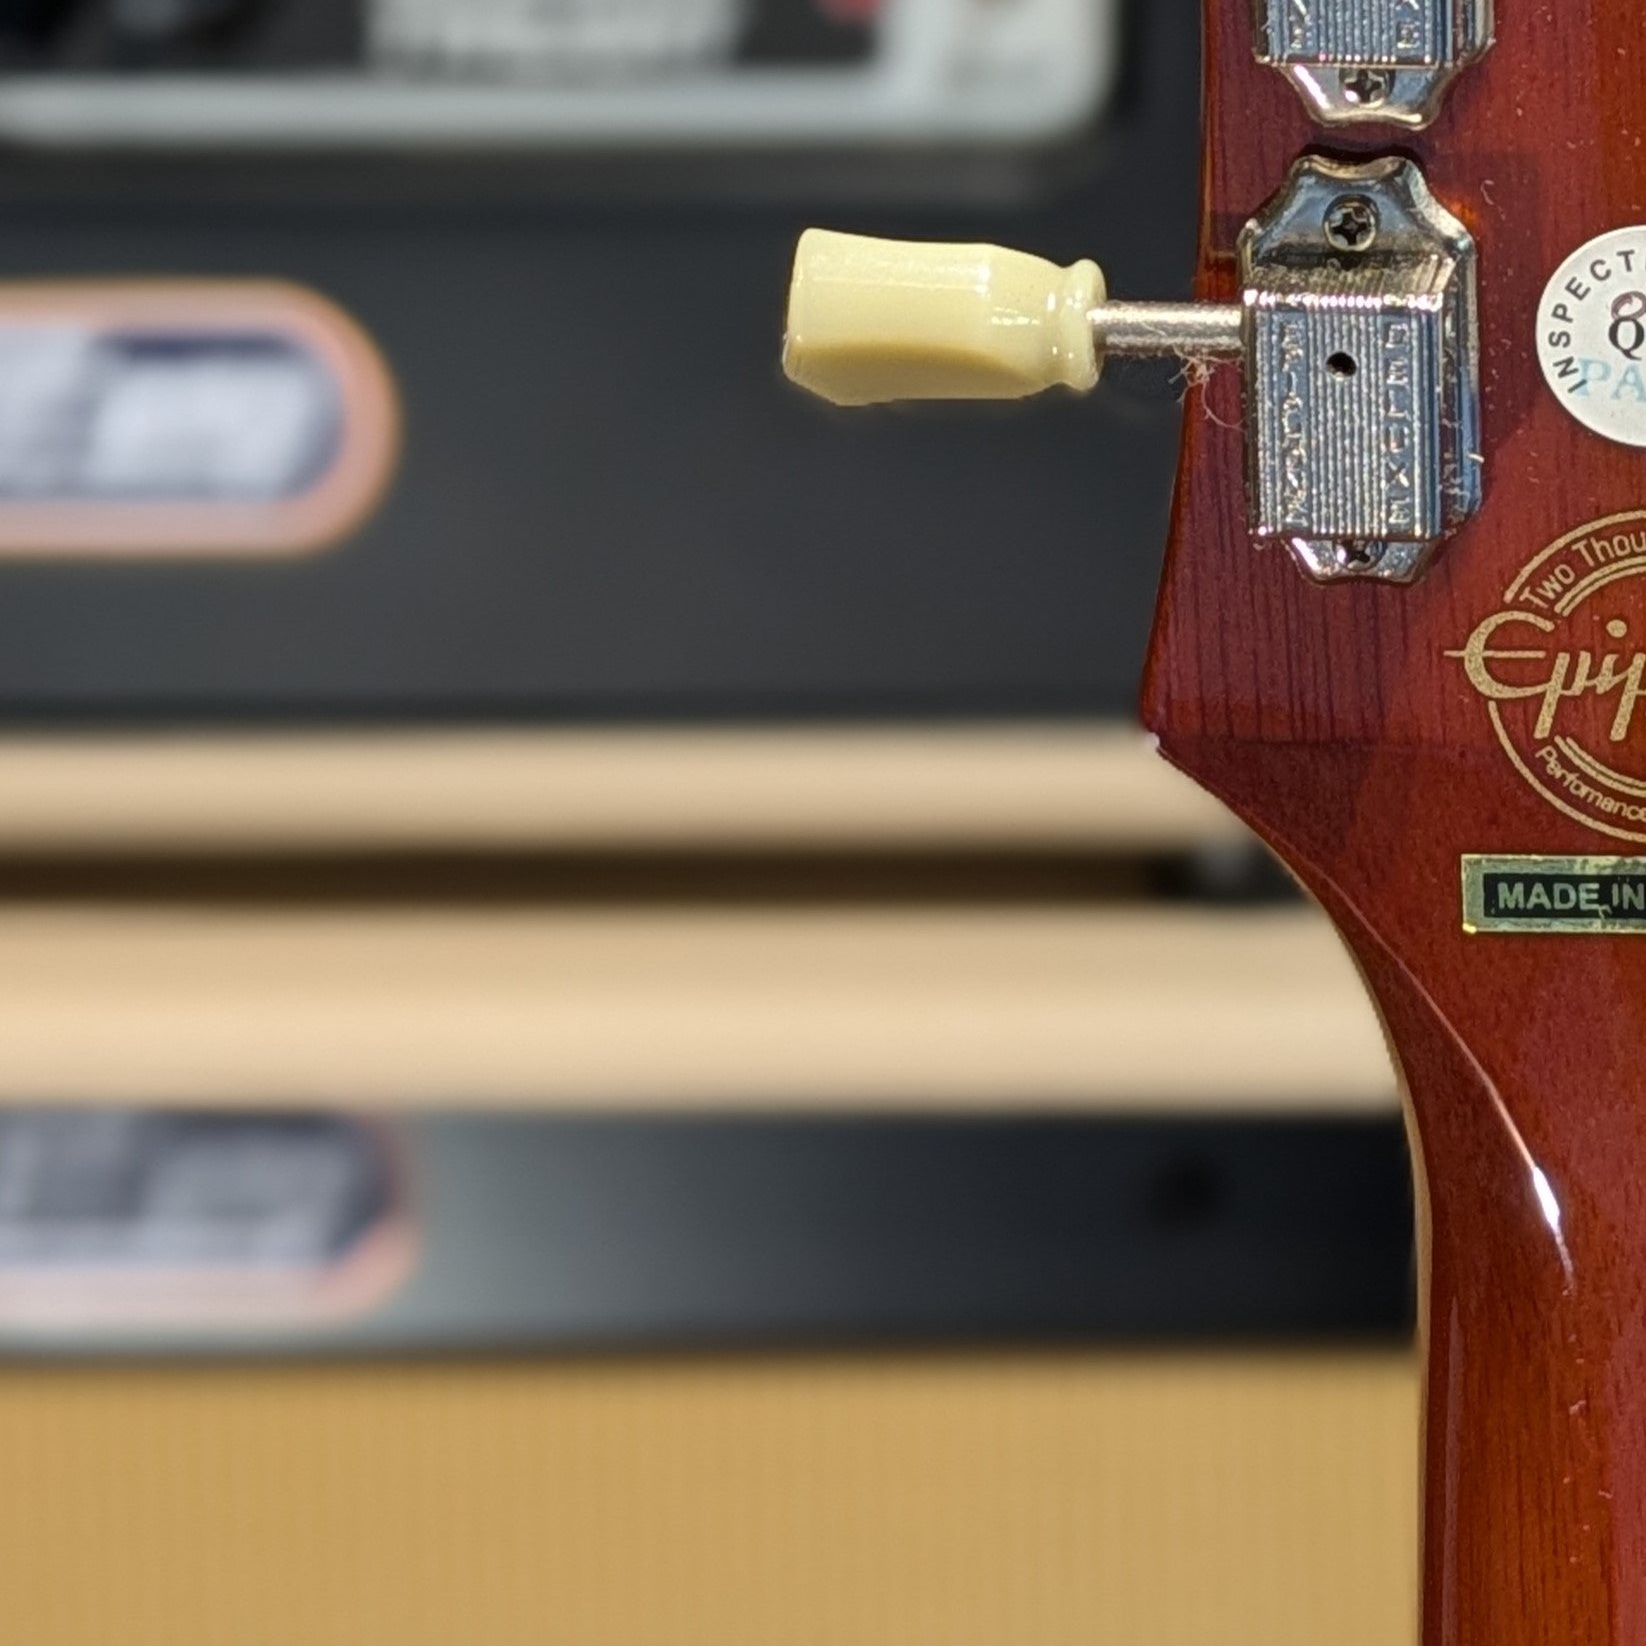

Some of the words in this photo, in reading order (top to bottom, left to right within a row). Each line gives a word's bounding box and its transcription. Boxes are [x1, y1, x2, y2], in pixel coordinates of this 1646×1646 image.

[1385, 322, 1411, 525] DELUXE
[1519, 563, 1576, 609] Two
[1498, 881, 1600, 911] MADE
[1611, 882, 1646, 911] IN
